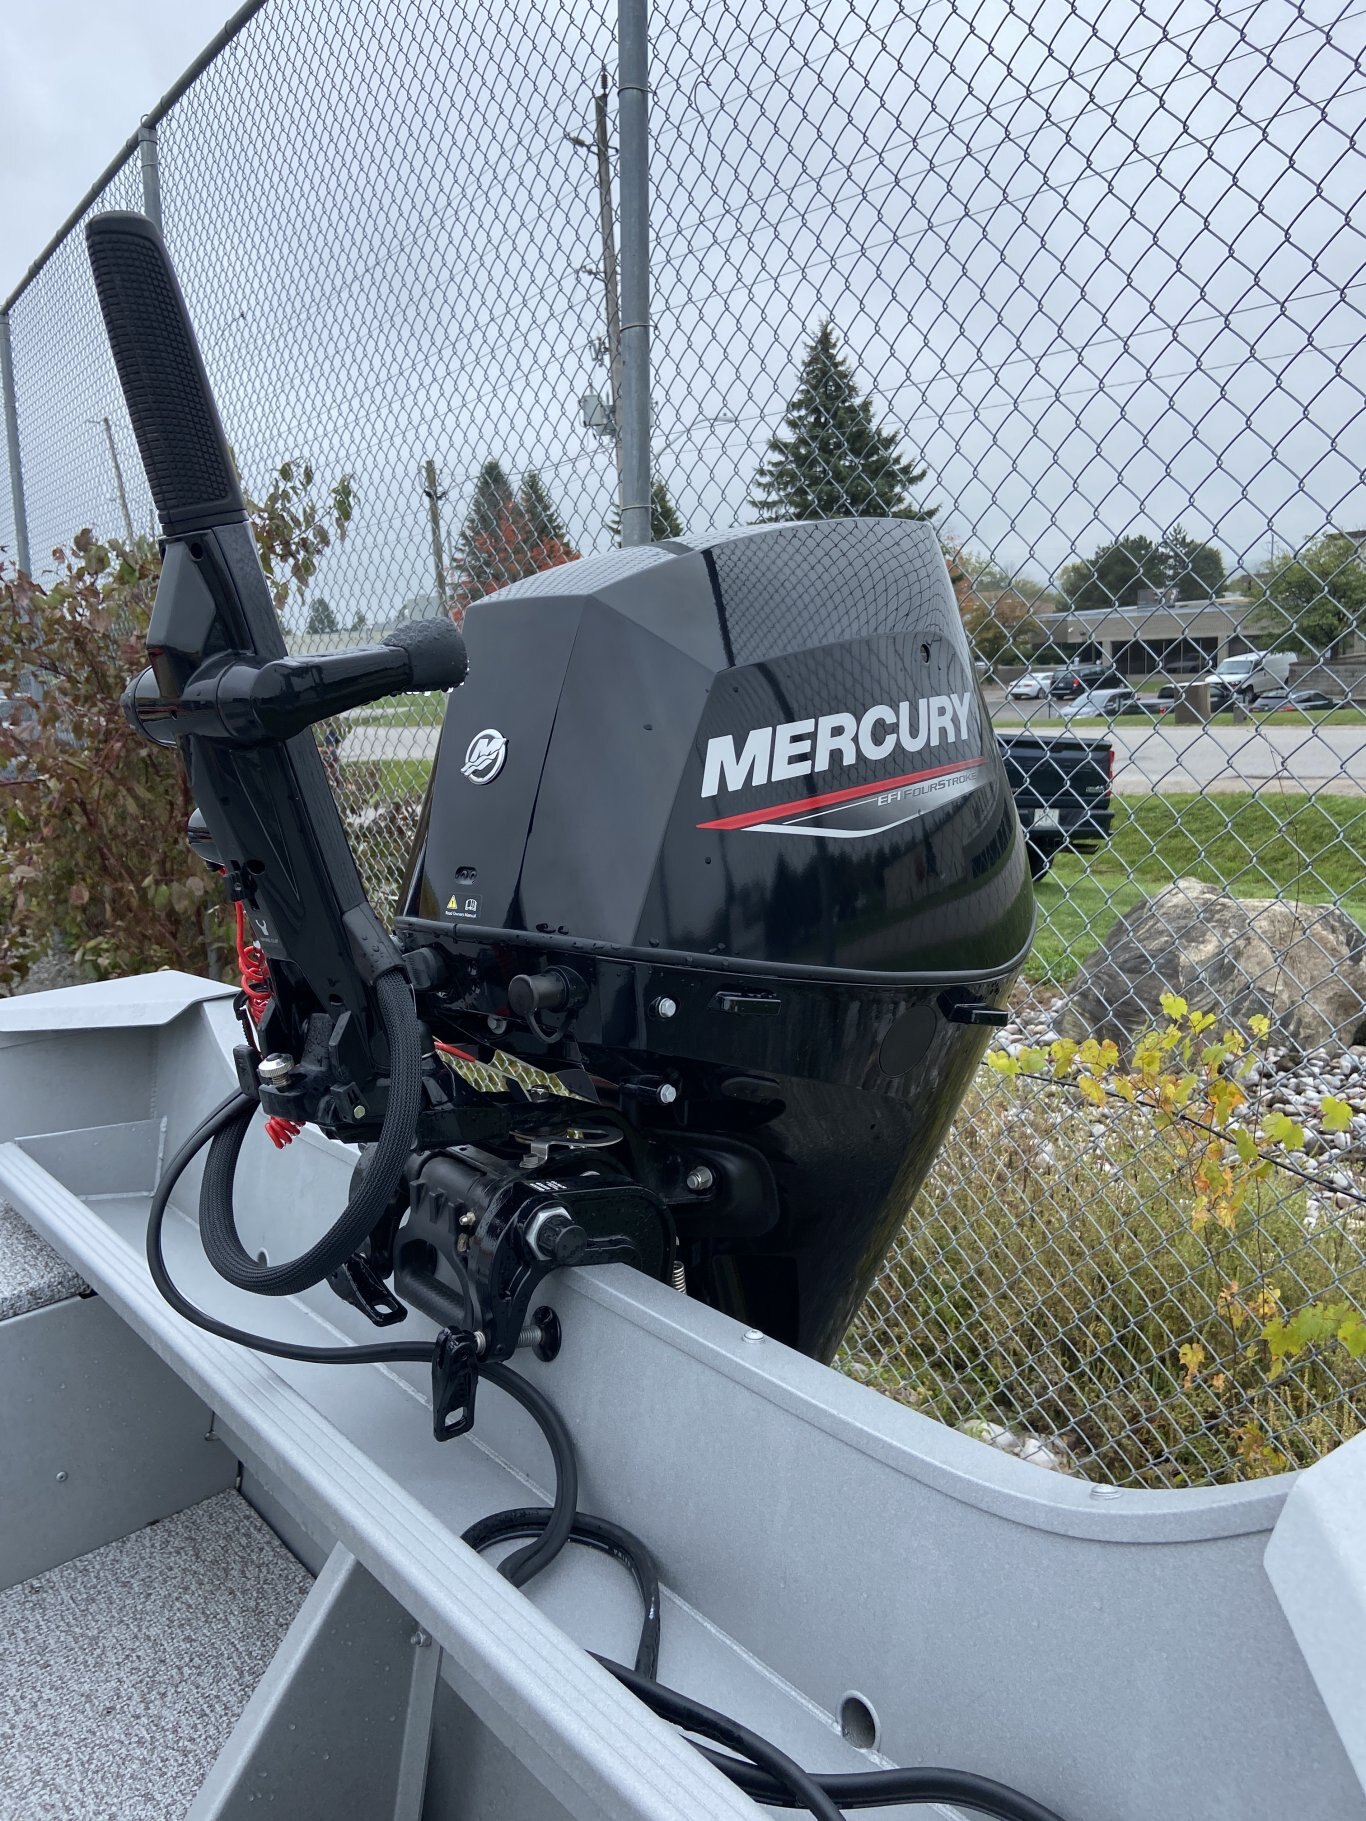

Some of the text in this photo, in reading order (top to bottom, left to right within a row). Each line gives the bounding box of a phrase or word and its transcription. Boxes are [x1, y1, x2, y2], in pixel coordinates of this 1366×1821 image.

[701, 692, 971, 798] MERCURY
[877, 771, 977, 807] EFI FOURSTROKE
